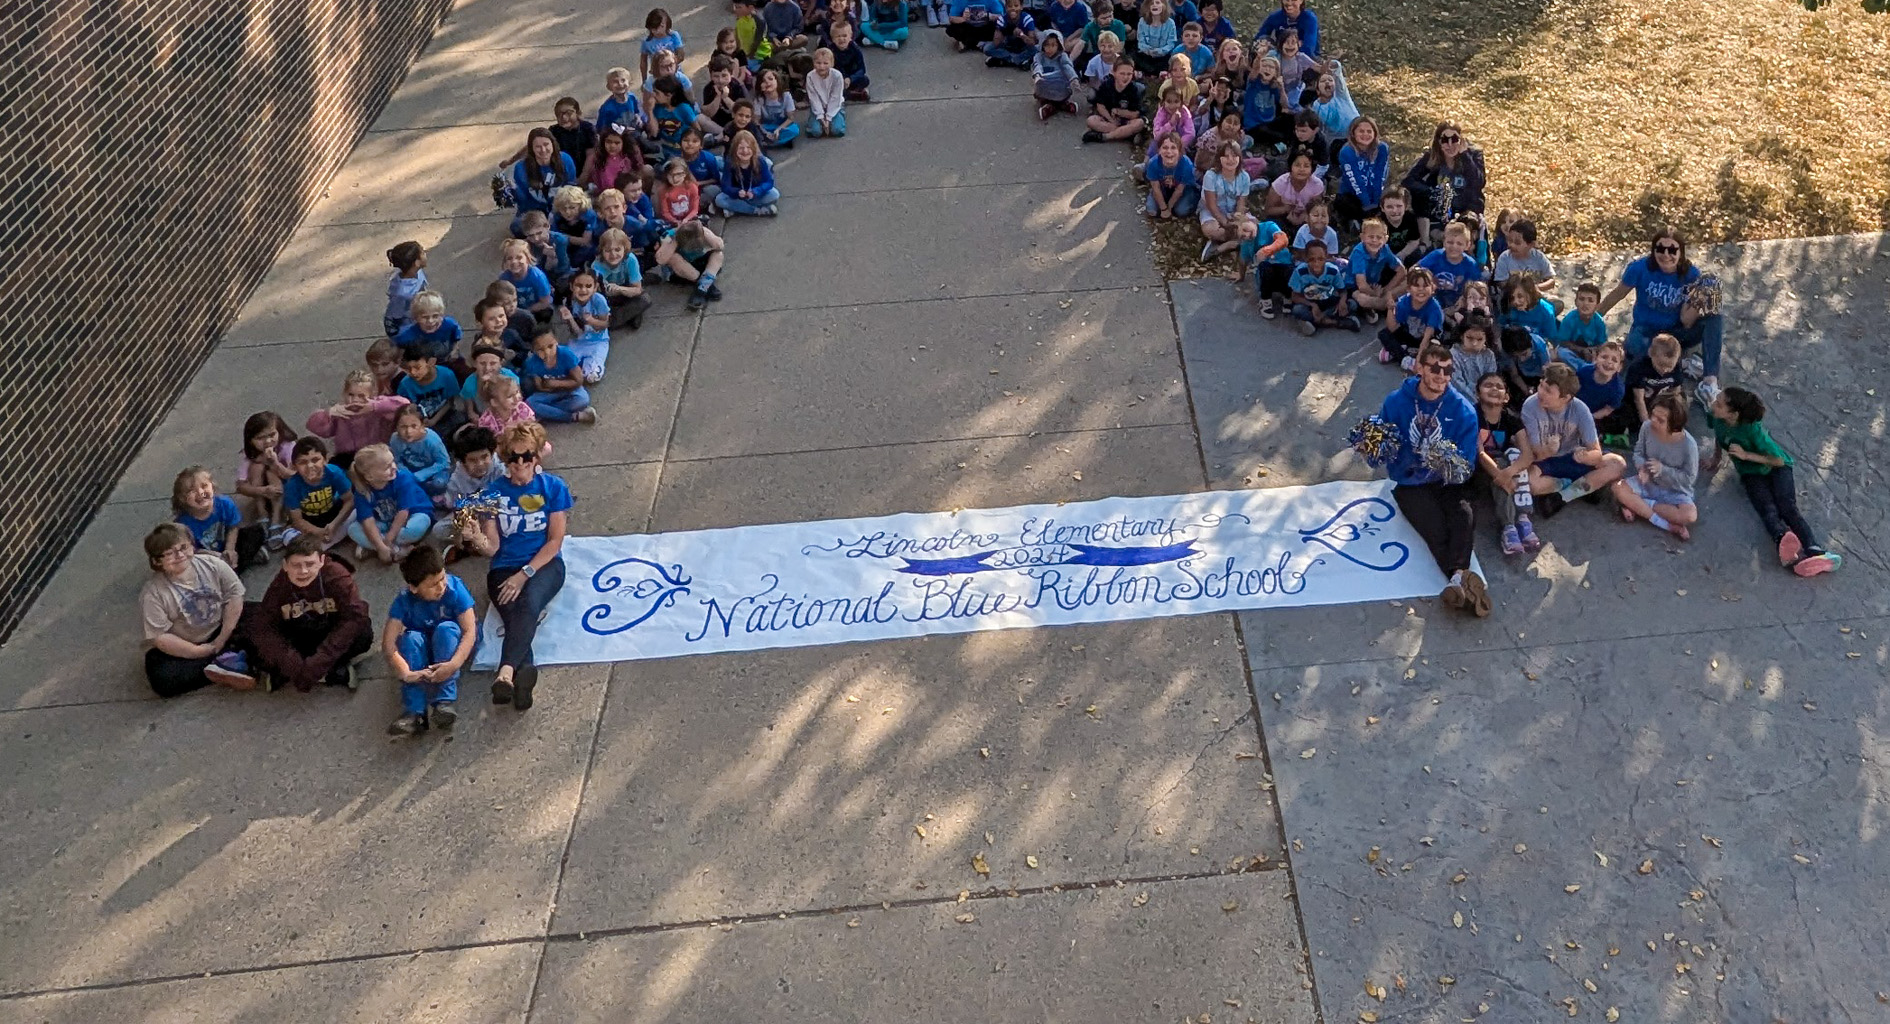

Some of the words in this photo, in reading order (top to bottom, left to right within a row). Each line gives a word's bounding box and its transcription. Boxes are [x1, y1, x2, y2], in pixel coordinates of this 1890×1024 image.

[838, 530, 998, 558] Lincoln
[1020, 515, 1190, 546] Elementary
[996, 546, 1070, 567] 2024
[685, 574, 899, 642] National
[901, 576, 1022, 623] Blue
[1018, 566, 1171, 610] Ribbon
[1171, 551, 1326, 601] School
